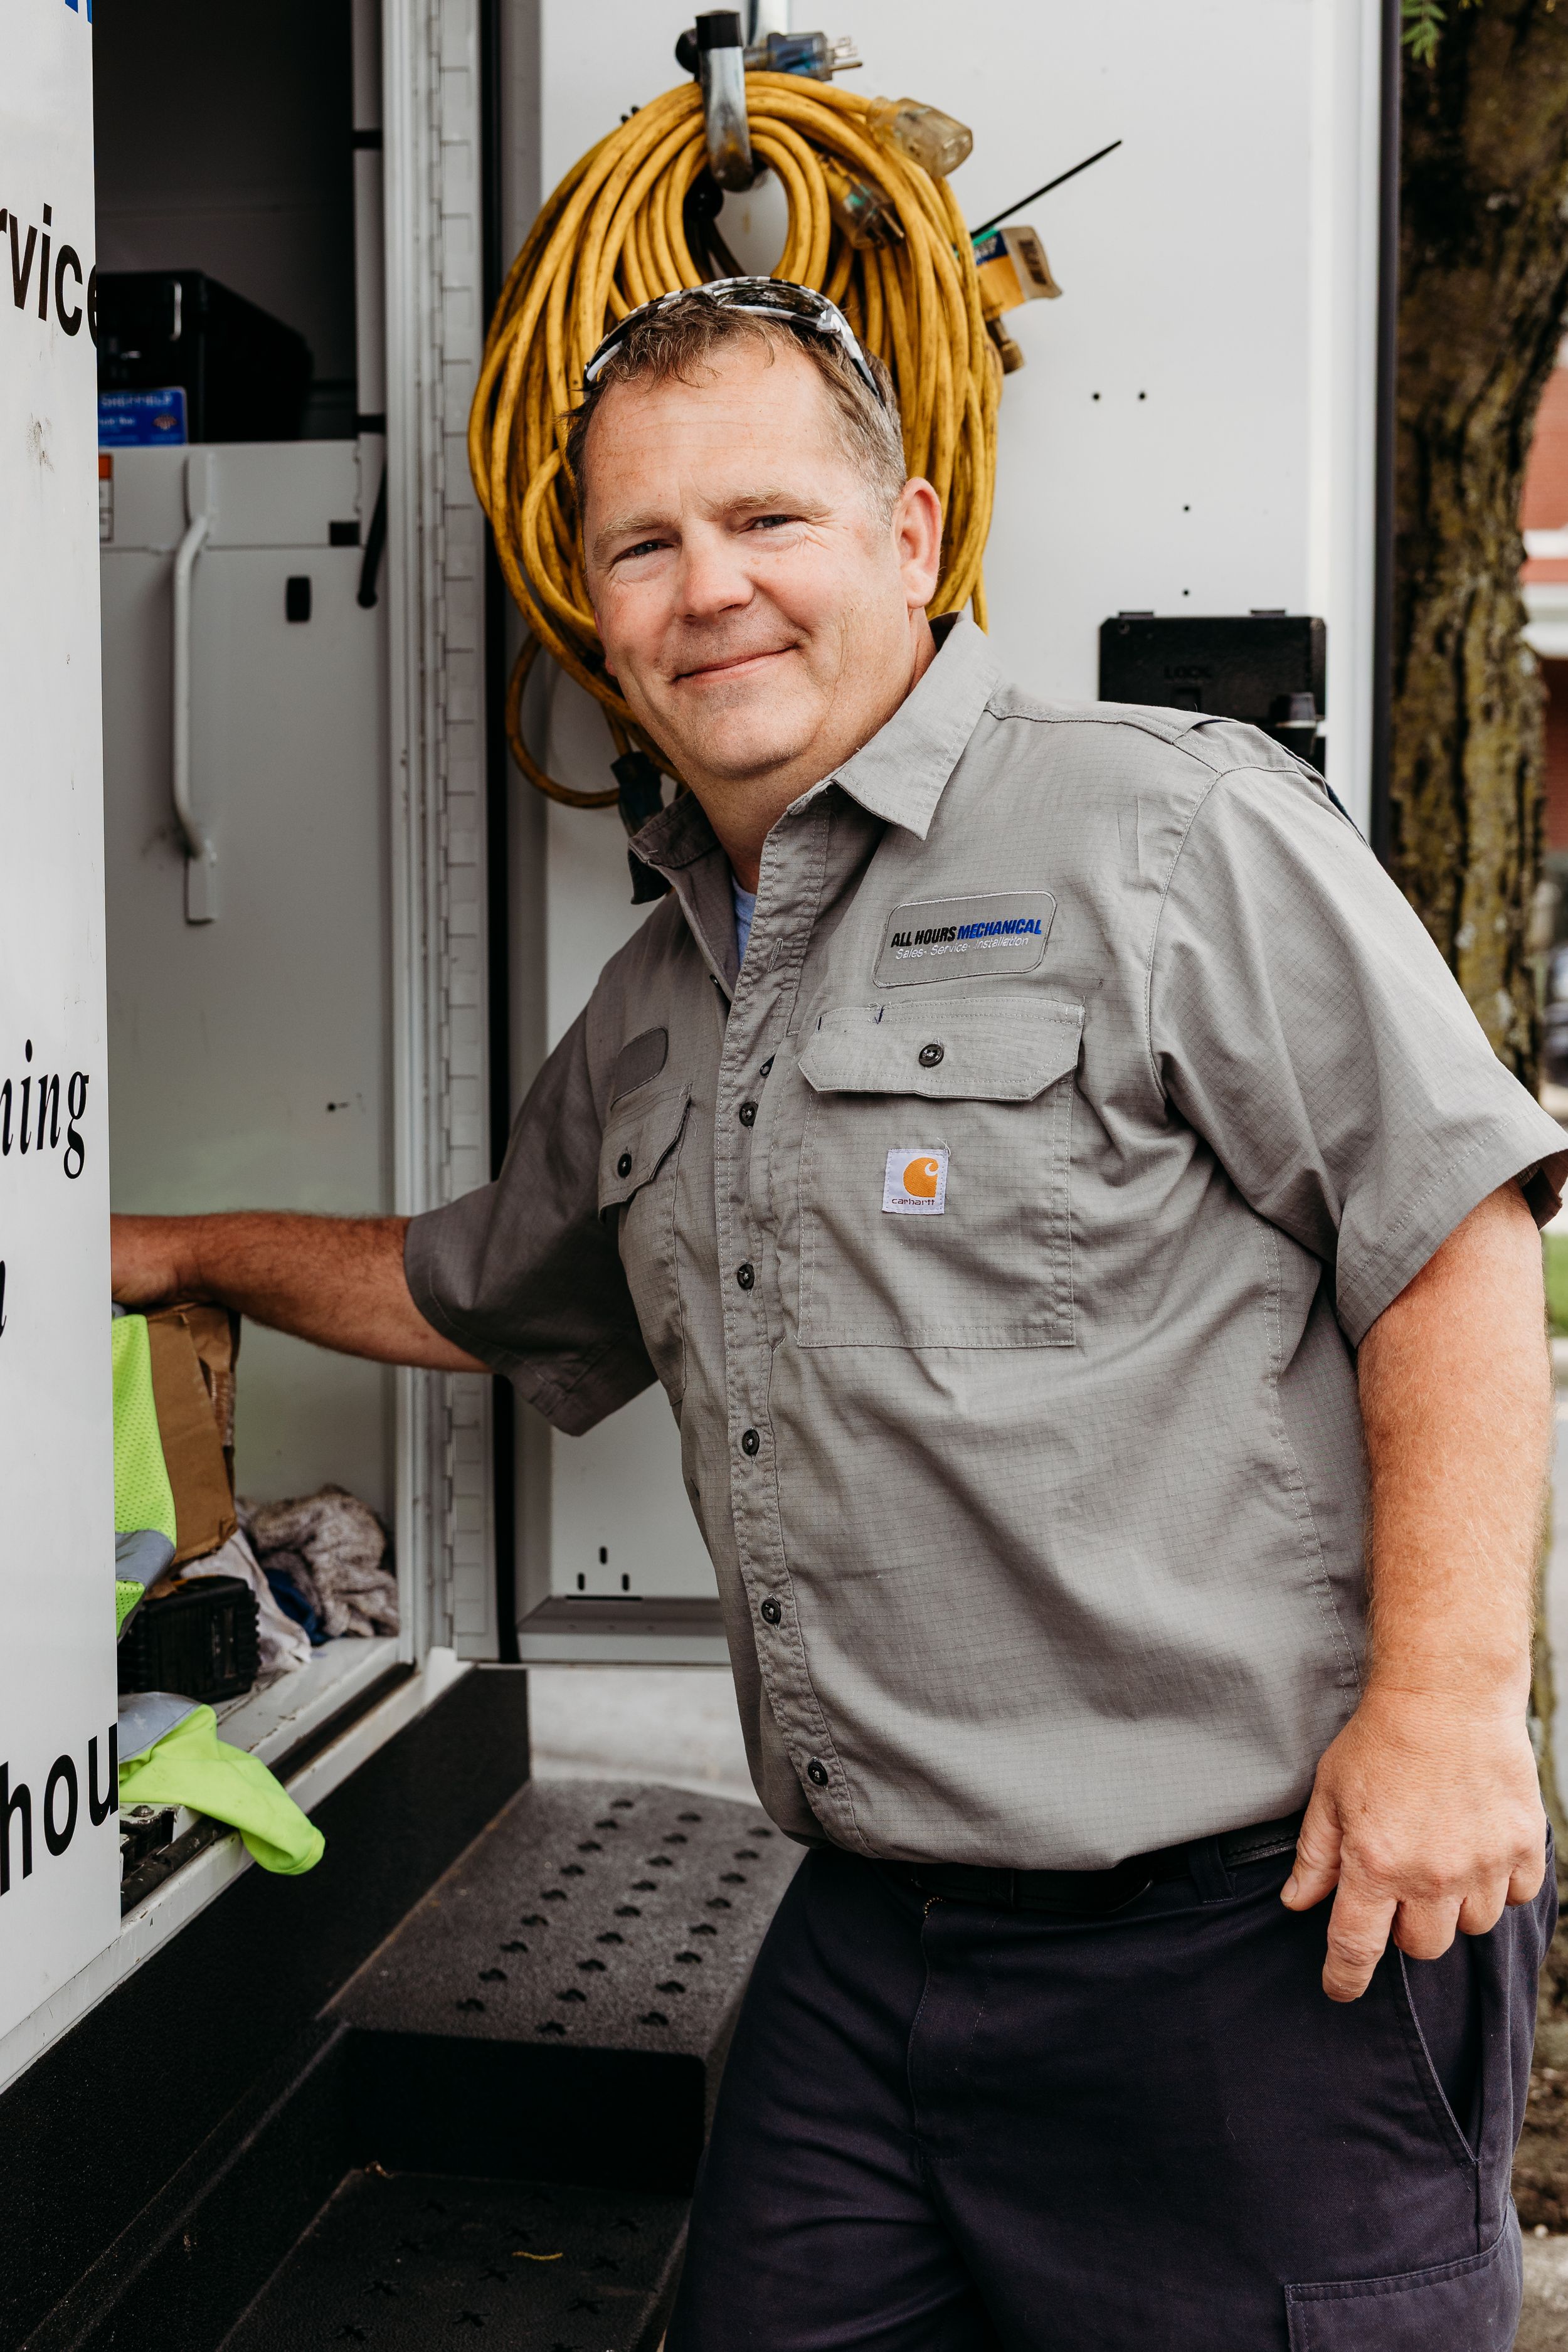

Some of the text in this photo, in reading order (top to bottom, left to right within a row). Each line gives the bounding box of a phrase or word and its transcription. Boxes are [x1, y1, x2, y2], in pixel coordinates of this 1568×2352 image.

[891, 919, 1042, 947] ALL HOURS MECHANICAL
[973, 936, 1029, 950] Installation
